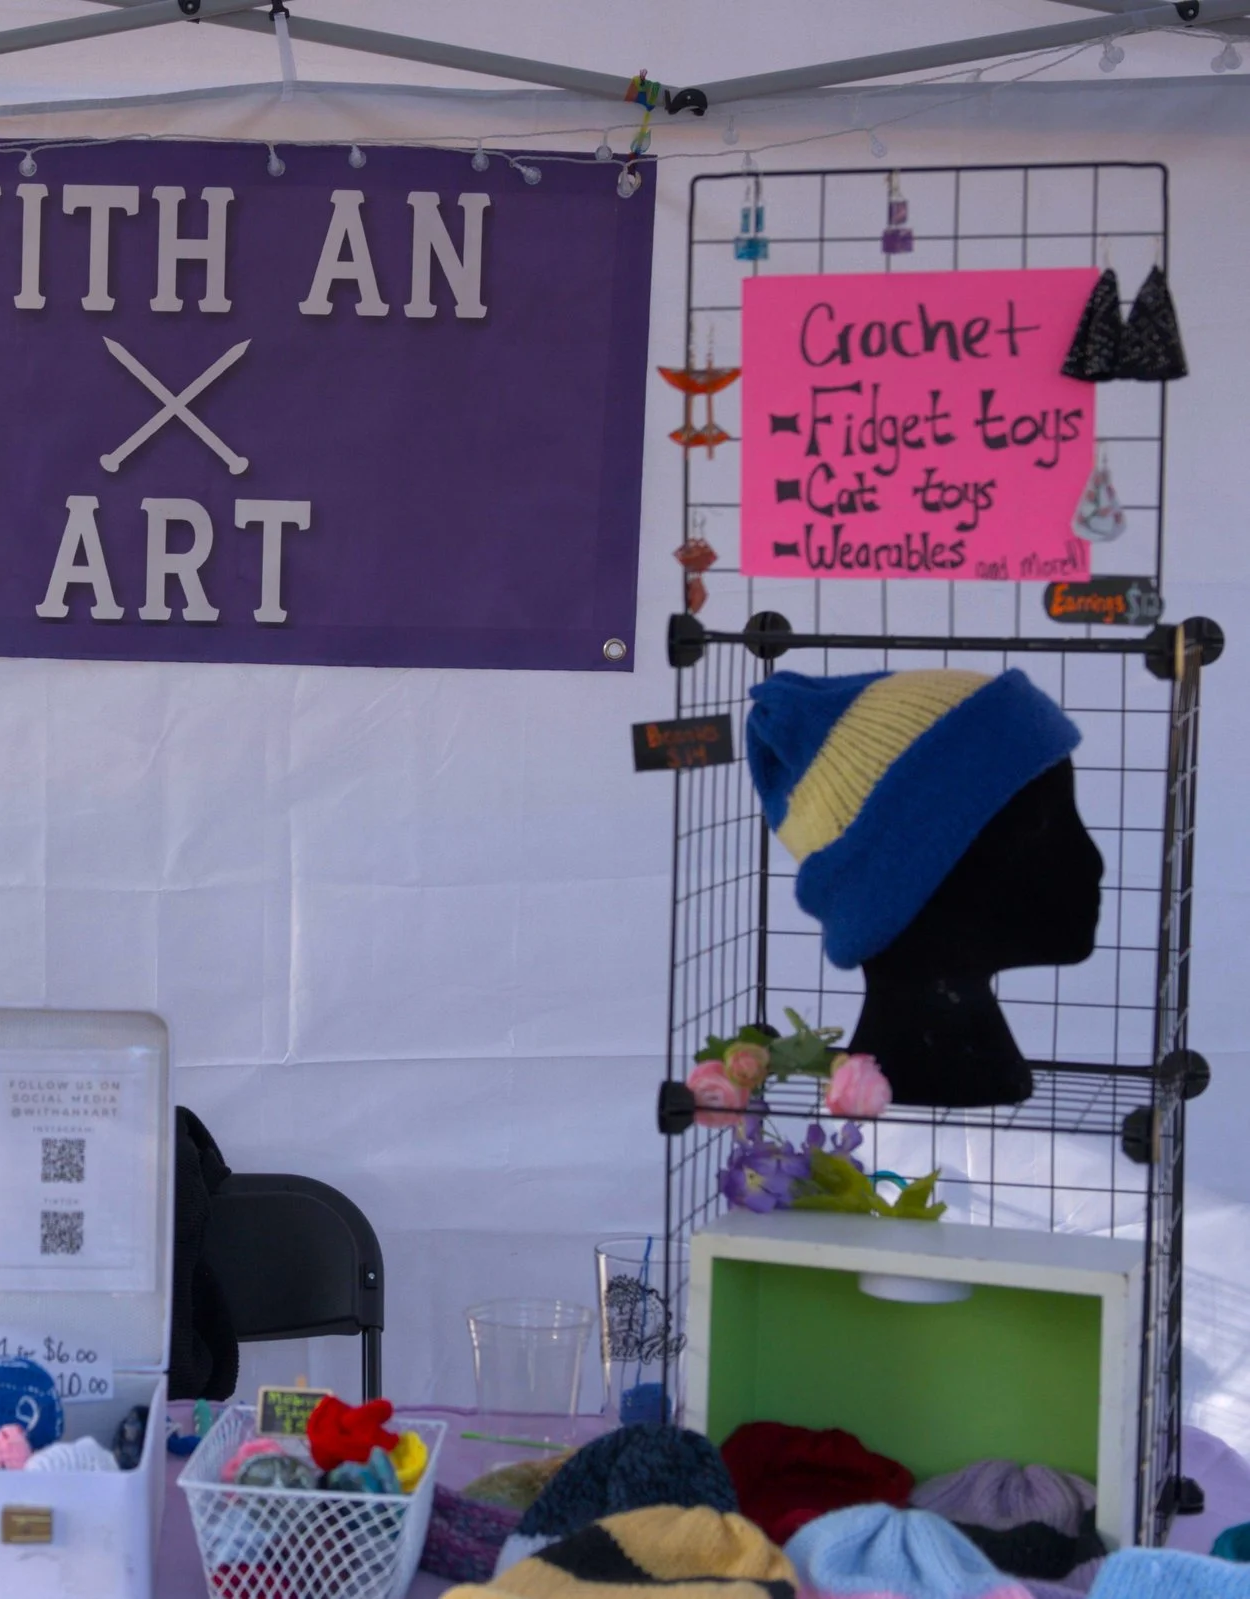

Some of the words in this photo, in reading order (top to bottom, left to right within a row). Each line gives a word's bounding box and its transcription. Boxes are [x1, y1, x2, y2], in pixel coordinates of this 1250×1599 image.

[298, 190, 491, 319] AN
[800, 300, 1042, 367] Crochet
[804, 380, 957, 477] Fidget
[974, 389, 1084, 468] toys
[806, 462, 880, 518] Cat
[911, 467, 998, 533] toys
[36, 495, 312, 624] ART
[803, 523, 968, 573] Wearables
[975, 557, 1009, 581] and
[1050, 582, 1127, 625] Earrings
[8, 1079, 70, 1091] FOLLOW
[75, 1080, 93, 1091] US
[100, 1080, 121, 1091] ON
[10, 1093, 63, 1104] SOCIAL
[71, 1094, 118, 1104] MEDIA
[42, 1335, 99, 1364] $6.00
